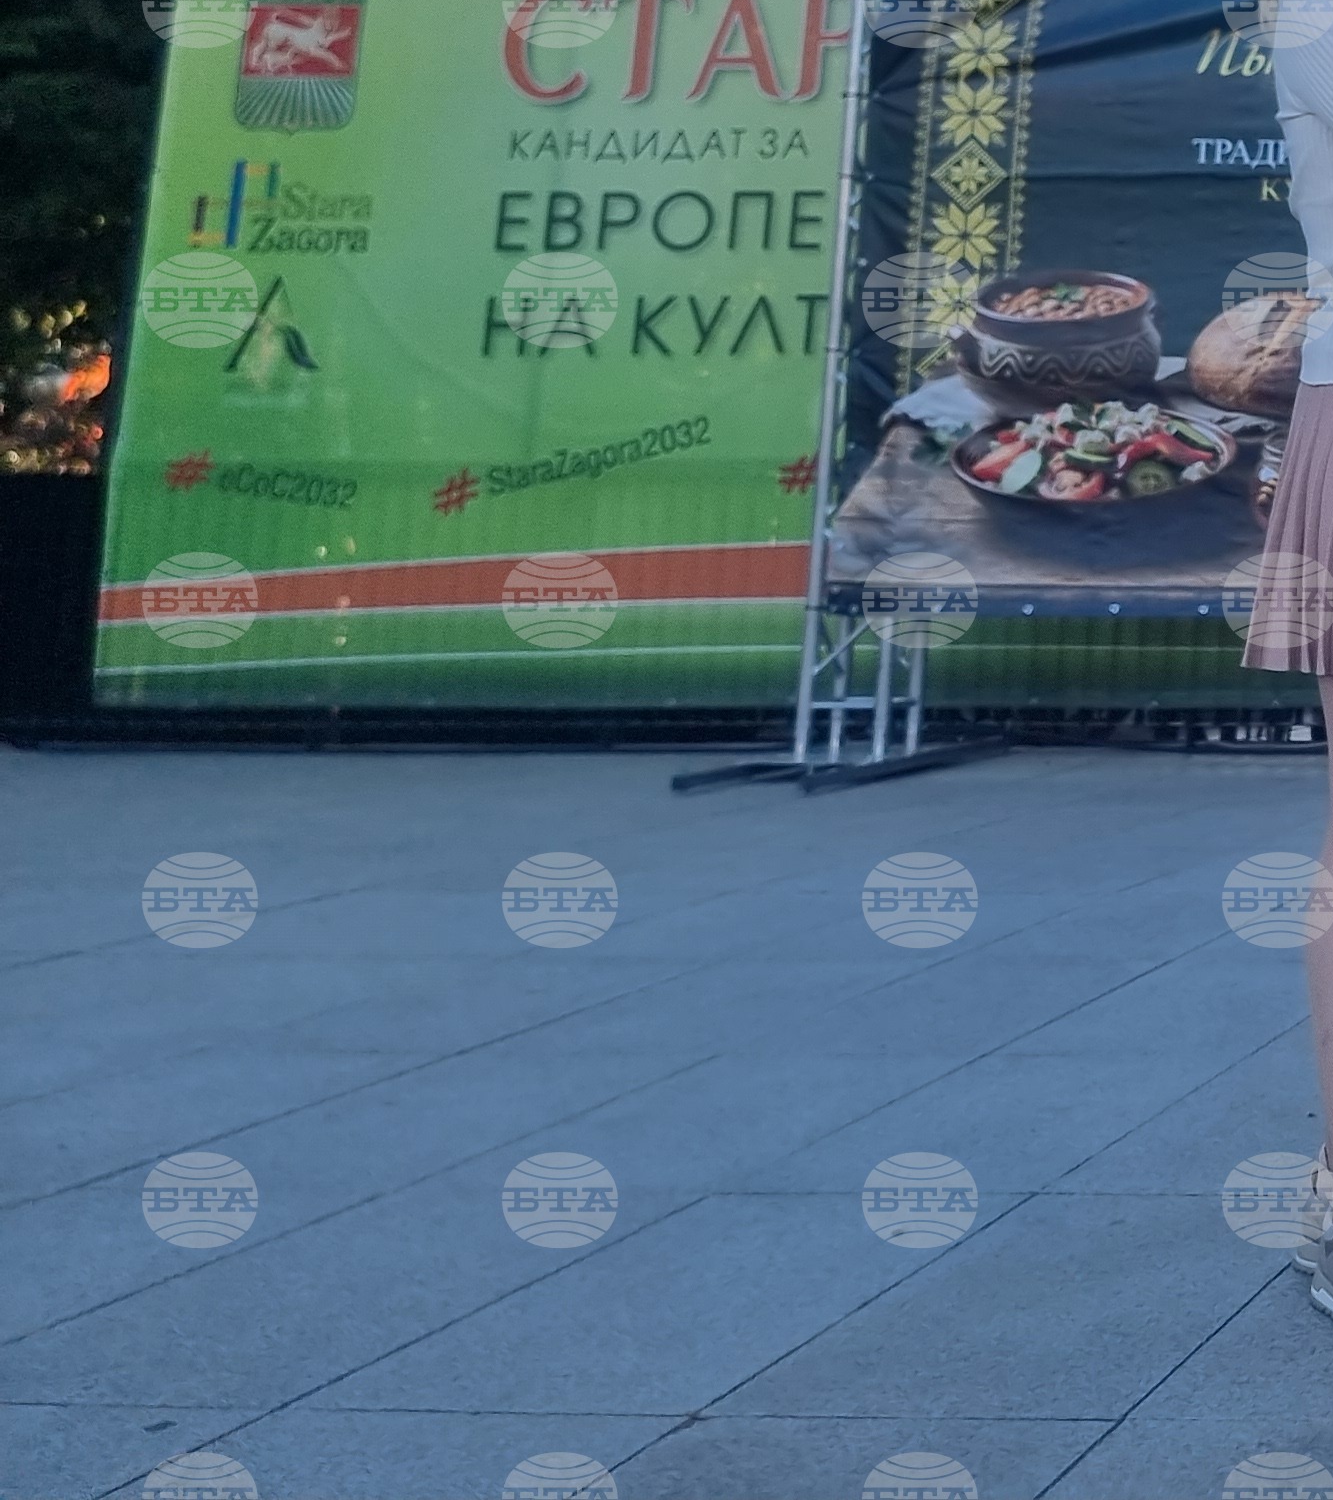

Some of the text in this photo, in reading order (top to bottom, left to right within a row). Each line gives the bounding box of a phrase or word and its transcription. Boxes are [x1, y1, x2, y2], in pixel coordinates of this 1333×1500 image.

[507, 127, 809, 162] КАНДИДАТ ЗА
[495, 189, 827, 251] ЕВРОПЕ
[481, 295, 830, 357] НА КУЛТ
